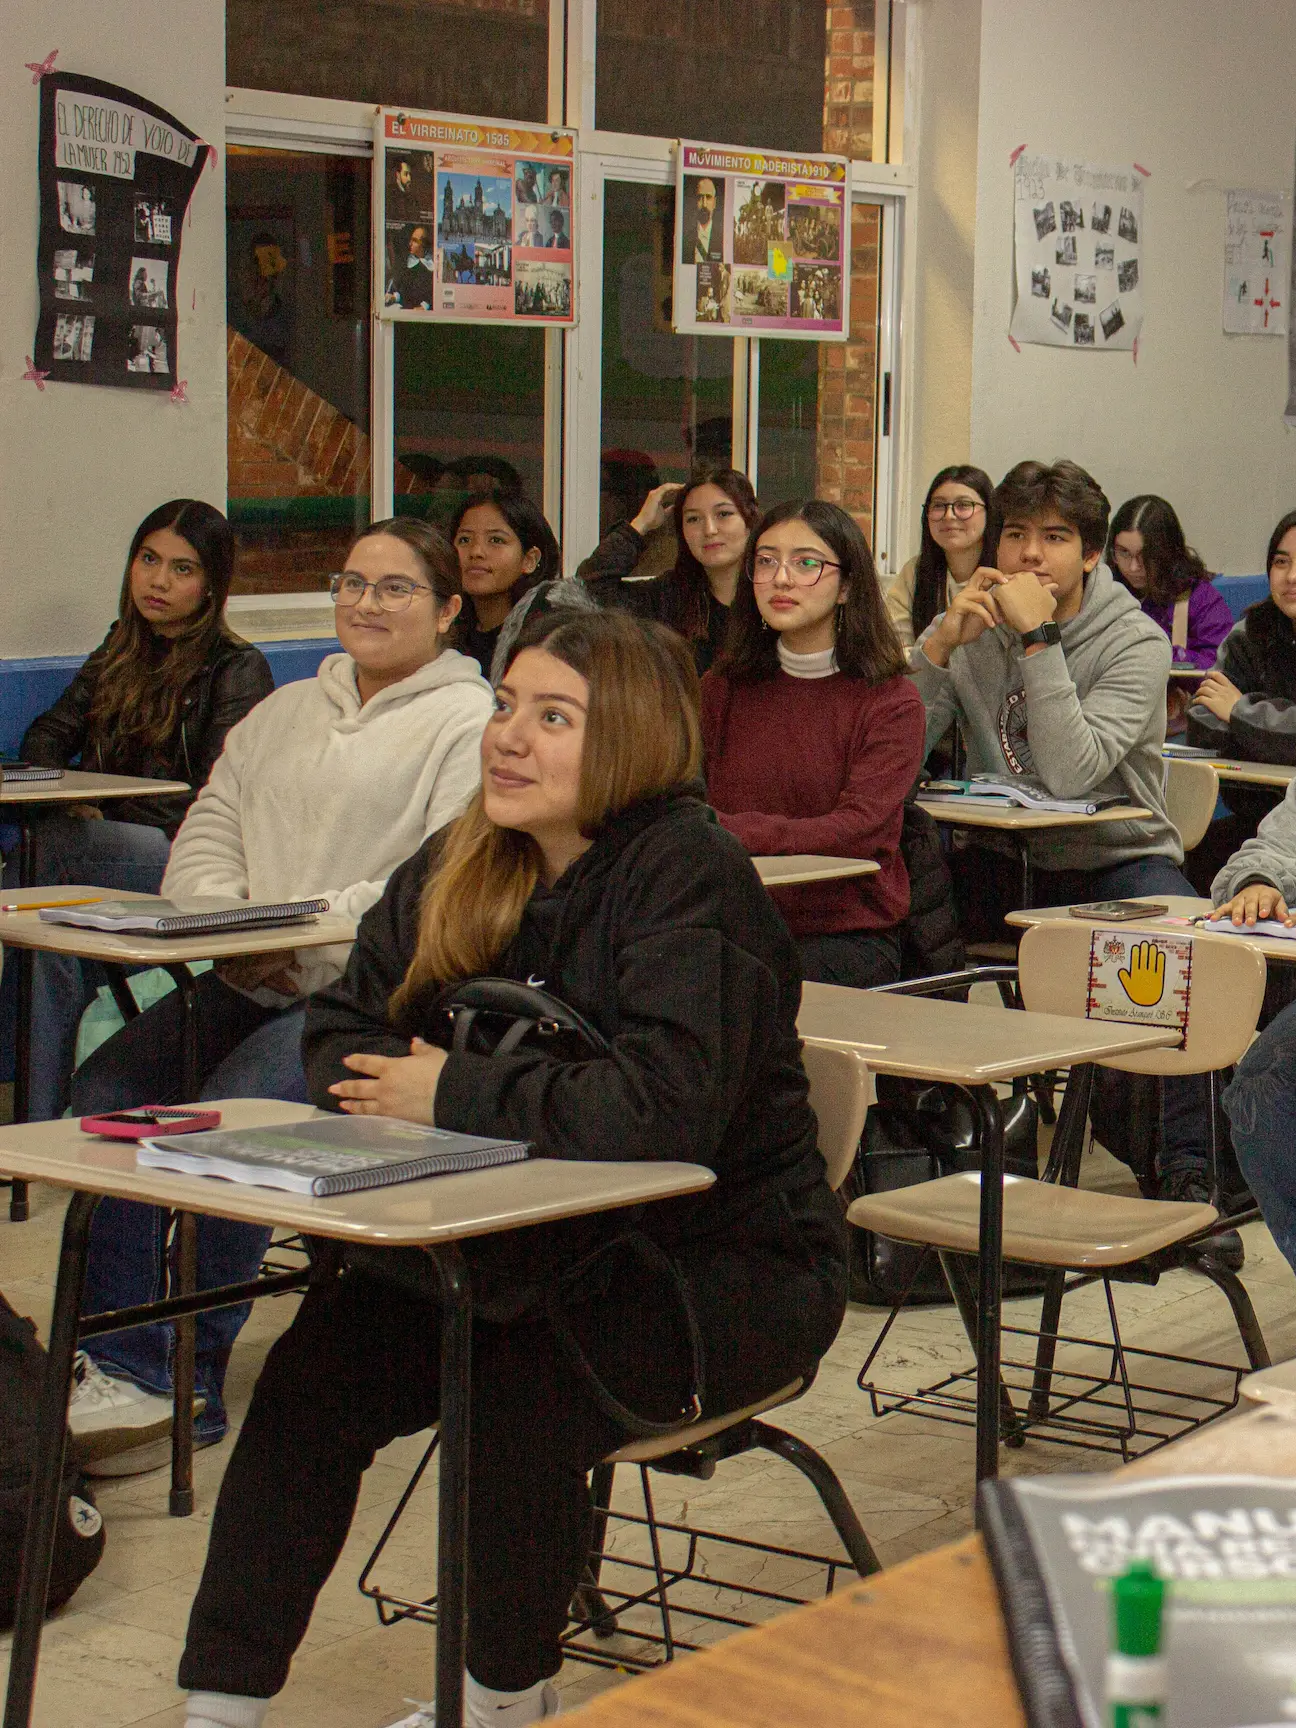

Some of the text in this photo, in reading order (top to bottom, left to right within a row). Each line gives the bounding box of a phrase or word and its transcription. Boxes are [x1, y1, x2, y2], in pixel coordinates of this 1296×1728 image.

[56, 101, 192, 165] EL DERECHO DE VOTO DE
[391, 121, 406, 135] EL
[410, 123, 478, 143] VIRREINATO
